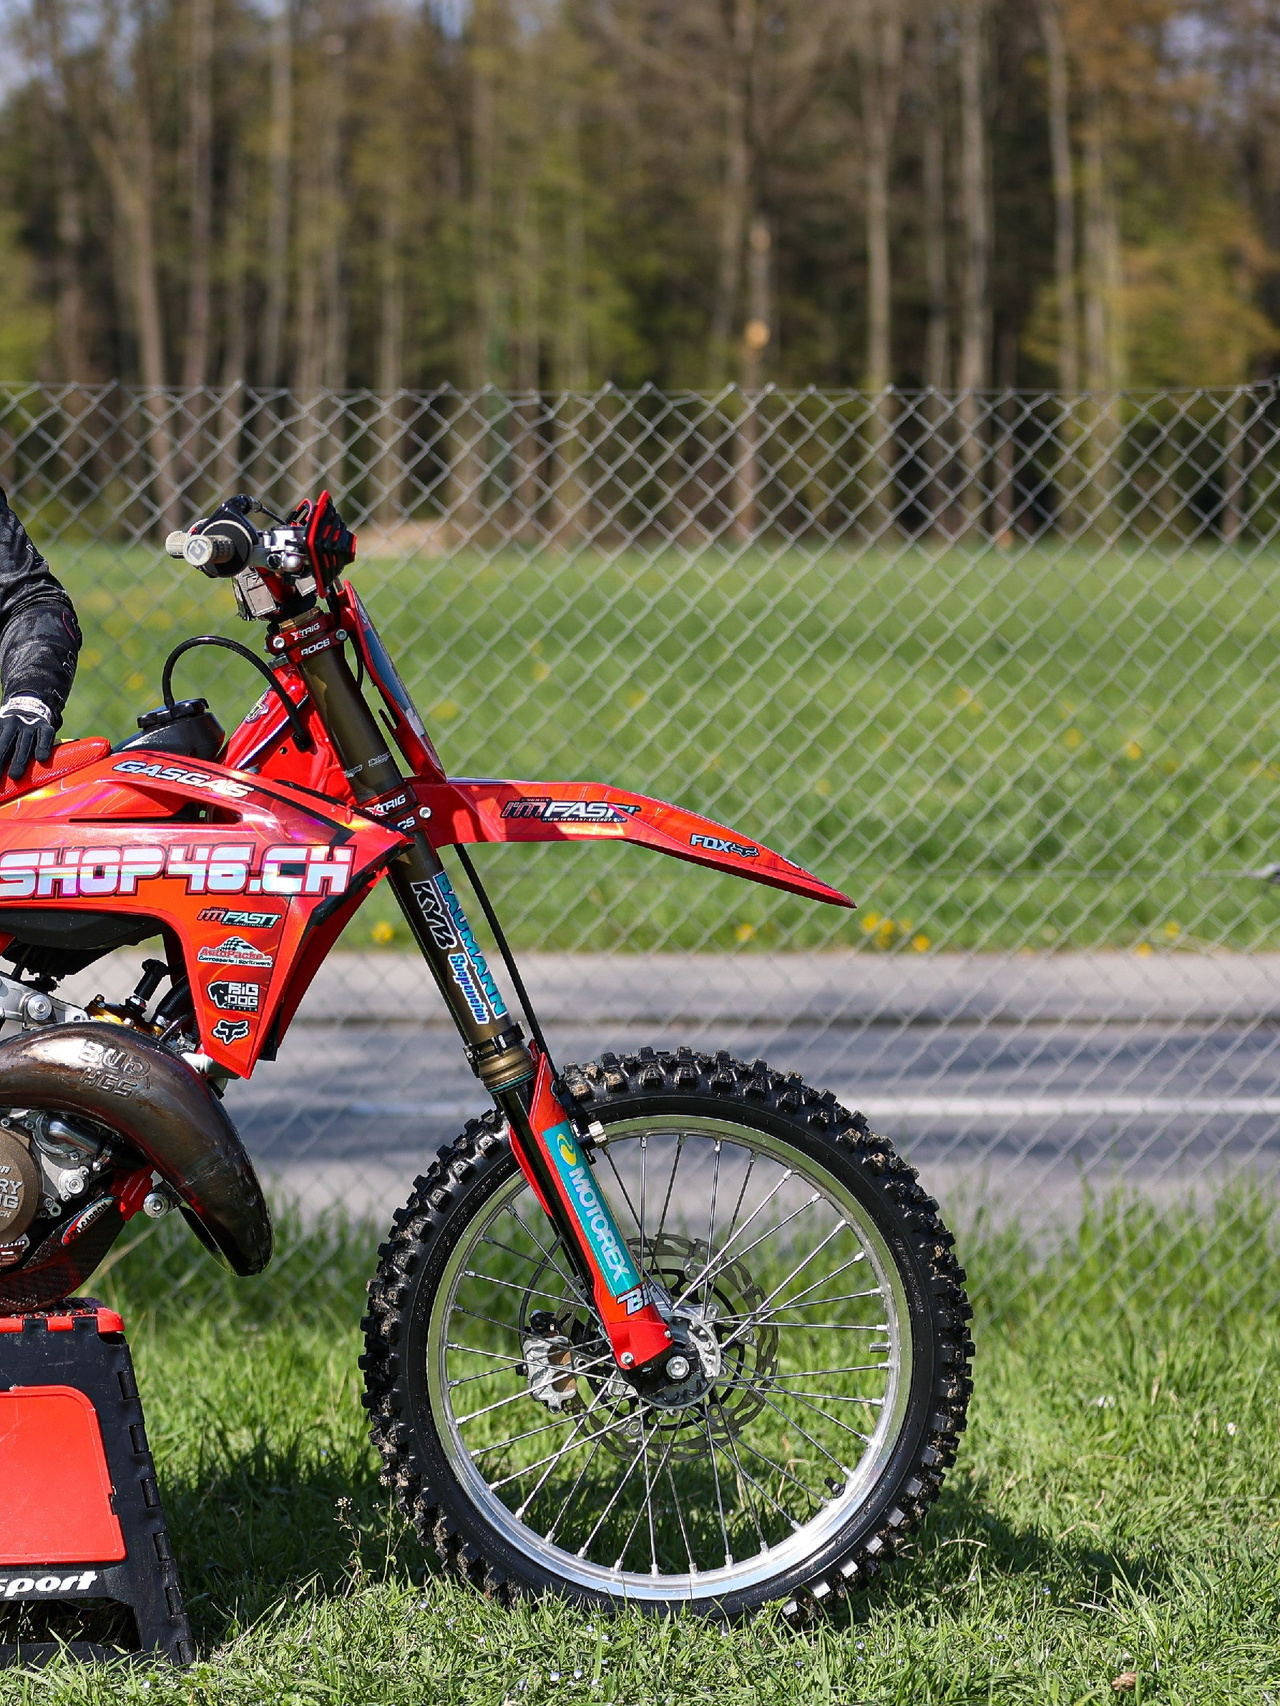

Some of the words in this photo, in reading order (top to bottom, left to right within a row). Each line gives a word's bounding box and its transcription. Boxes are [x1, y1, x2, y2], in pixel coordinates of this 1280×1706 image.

[301, 638, 331, 656] ROCS
[113, 760, 255, 798] GASGAS
[690, 834, 731, 853] FOX
[410, 880, 458, 950] KYB
[433, 870, 508, 1019] BAUMANN
[227, 995, 258, 1006] DOG
[448, 953, 489, 1024] Suspension
[78, 1041, 151, 1077] BUD
[80, 1067, 133, 1098] HGS
[569, 1165, 630, 1283] MOTOREX
